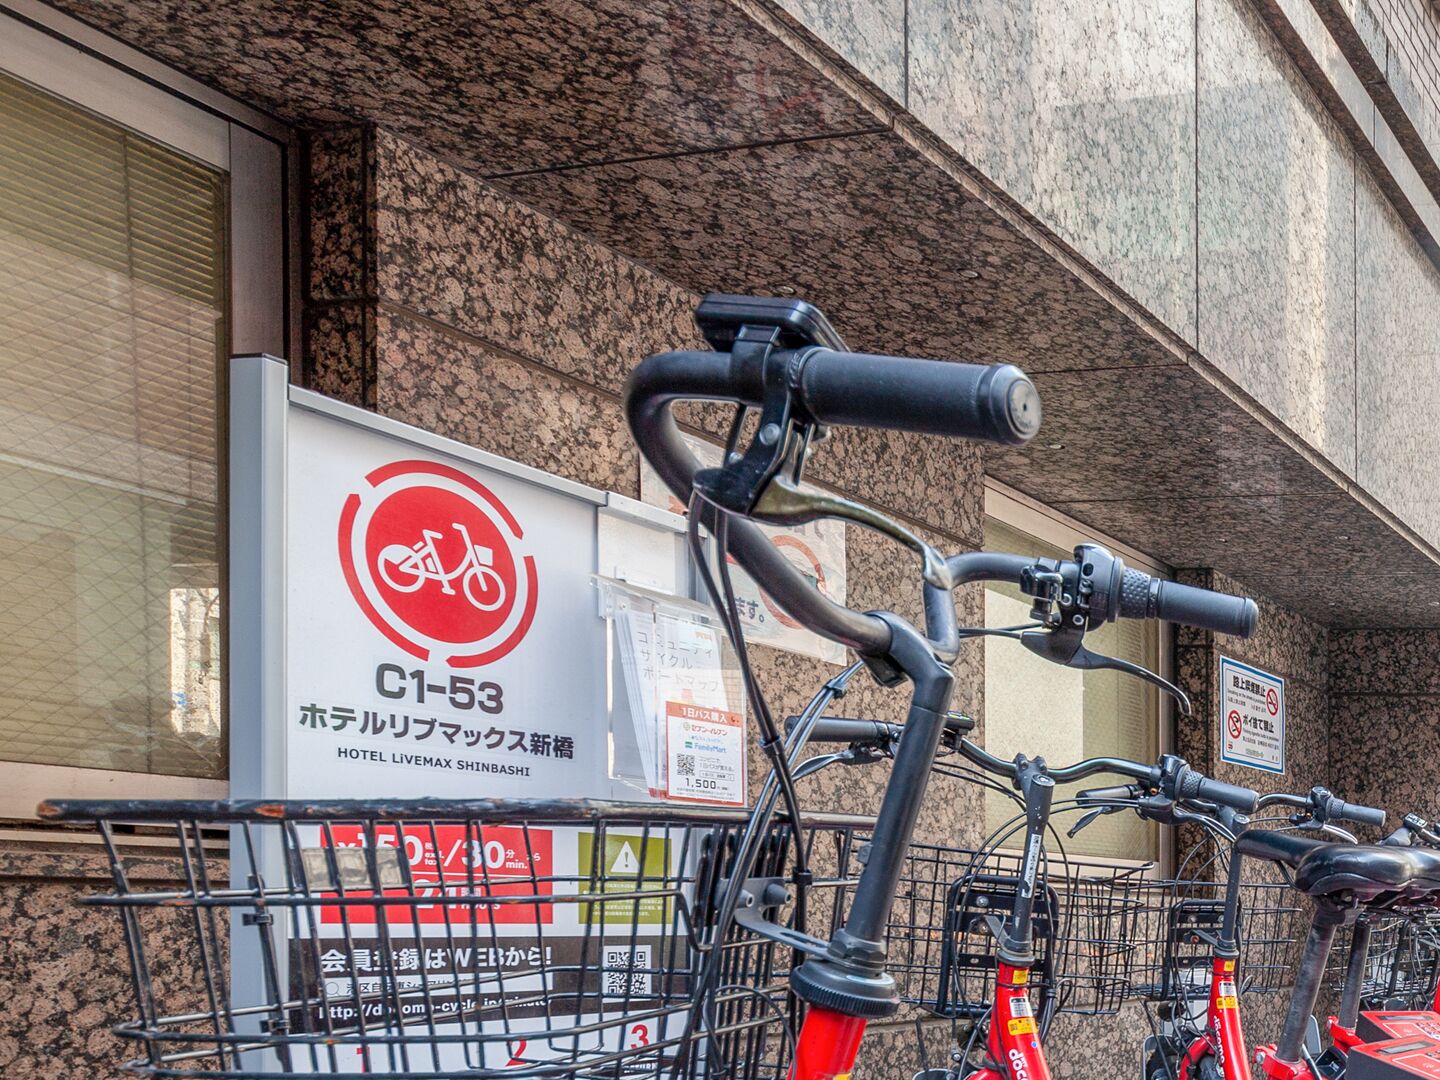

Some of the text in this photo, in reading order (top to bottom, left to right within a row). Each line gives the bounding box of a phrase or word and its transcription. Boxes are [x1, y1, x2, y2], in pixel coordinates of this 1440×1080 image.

[376, 662, 504, 715] C1-53
[299, 703, 575, 759] ホテルリブマックス新橋
[338, 747, 387, 763] HOTEL
[457, 760, 531, 777] SHINBASHI
[686, 778, 716, 789] 1,500
[505, 859, 528, 870] min.
[631, 1024, 649, 1050] 3
[505, 1039, 527, 1067] 2
